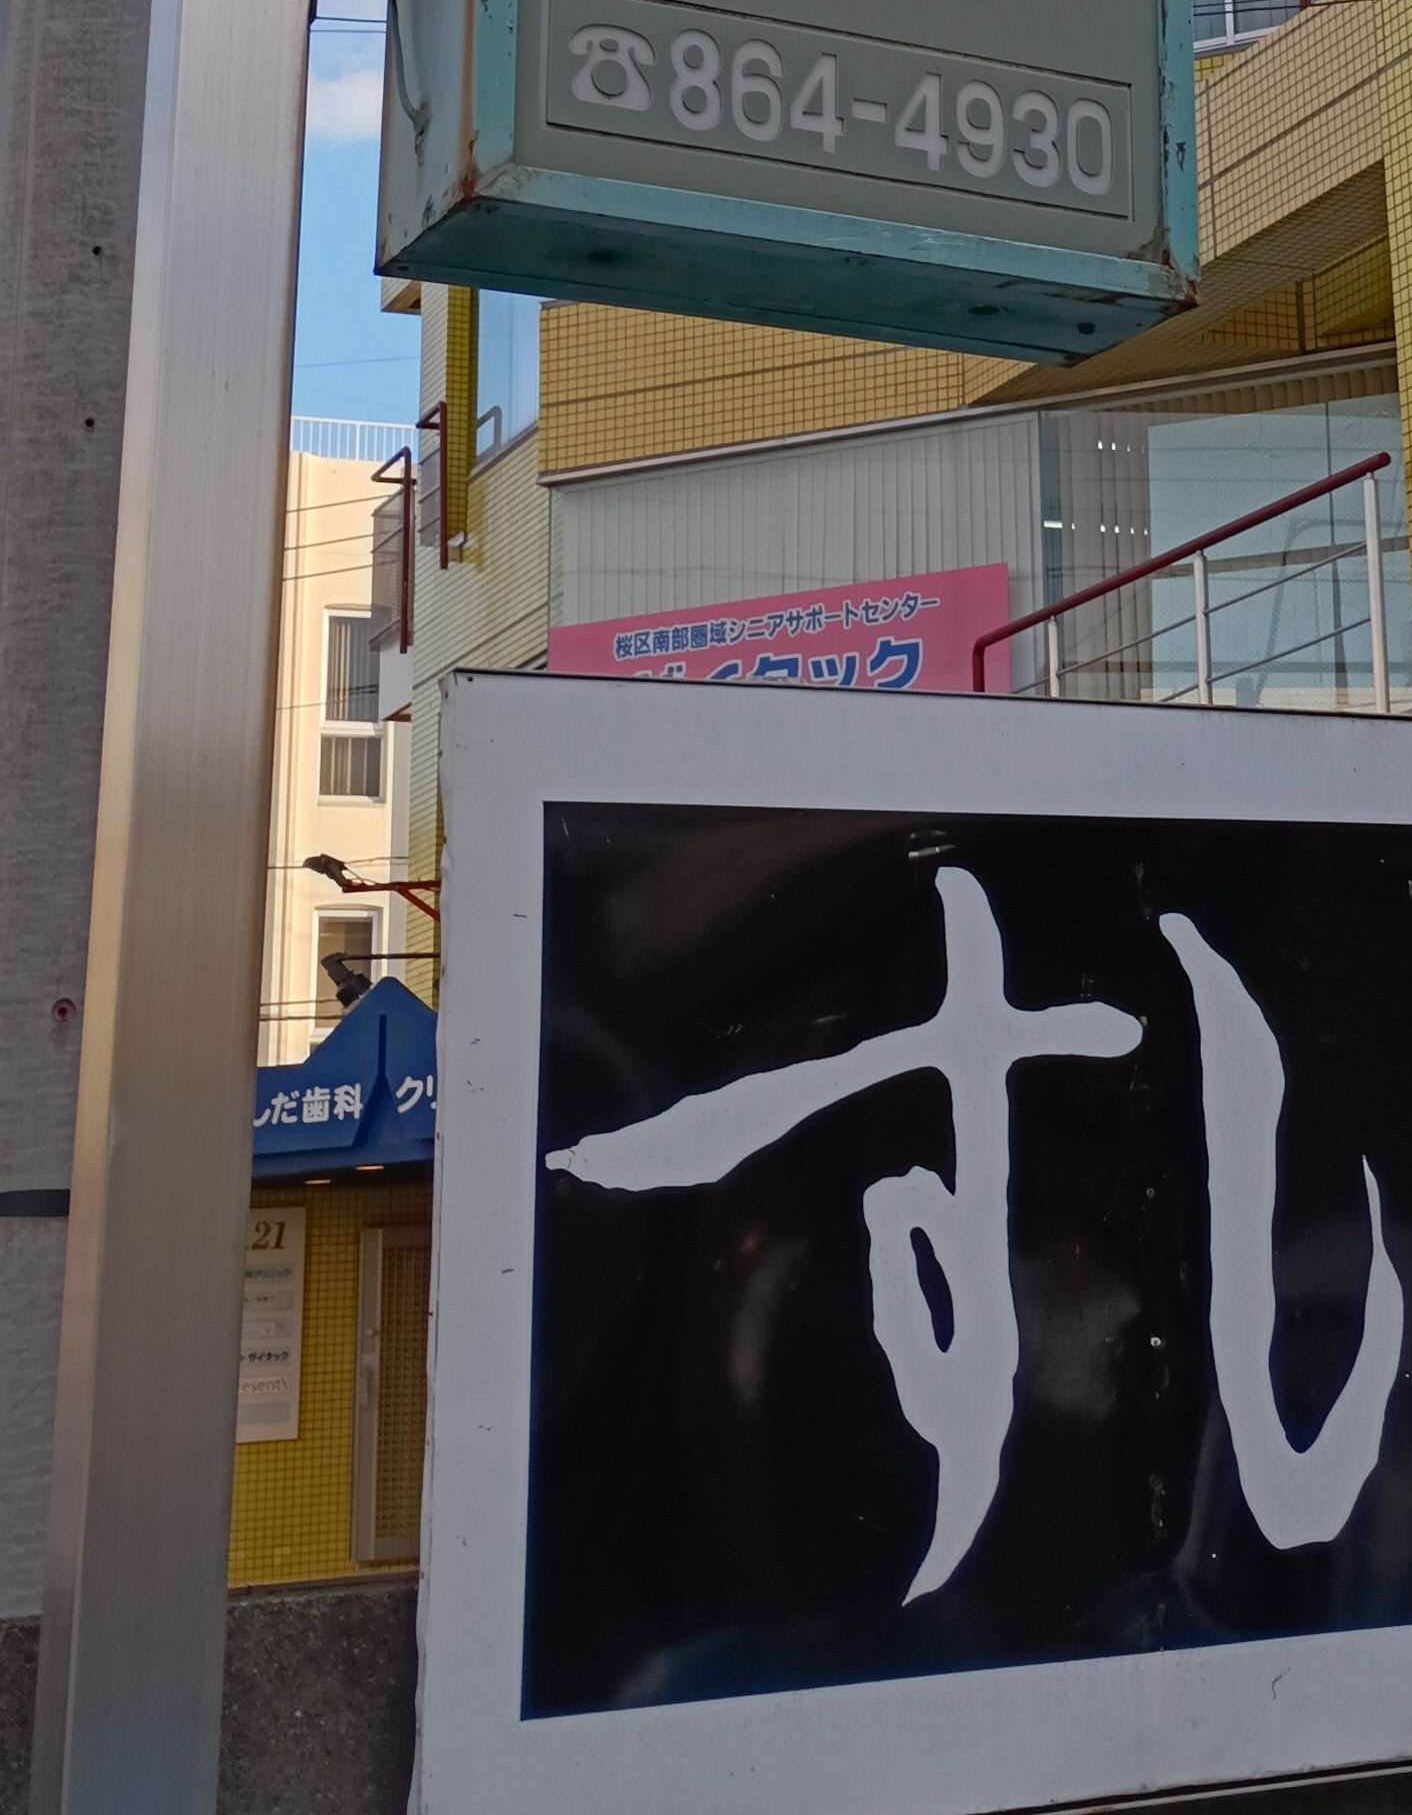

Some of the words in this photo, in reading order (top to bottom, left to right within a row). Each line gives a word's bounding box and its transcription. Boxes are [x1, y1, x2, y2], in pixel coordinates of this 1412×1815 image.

[668, 28, 1114, 196] 864-4930
[613, 592, 939, 661] 桜区南部圏域シニアサポートセンター
[545, 866, 1404, 1608] すし
